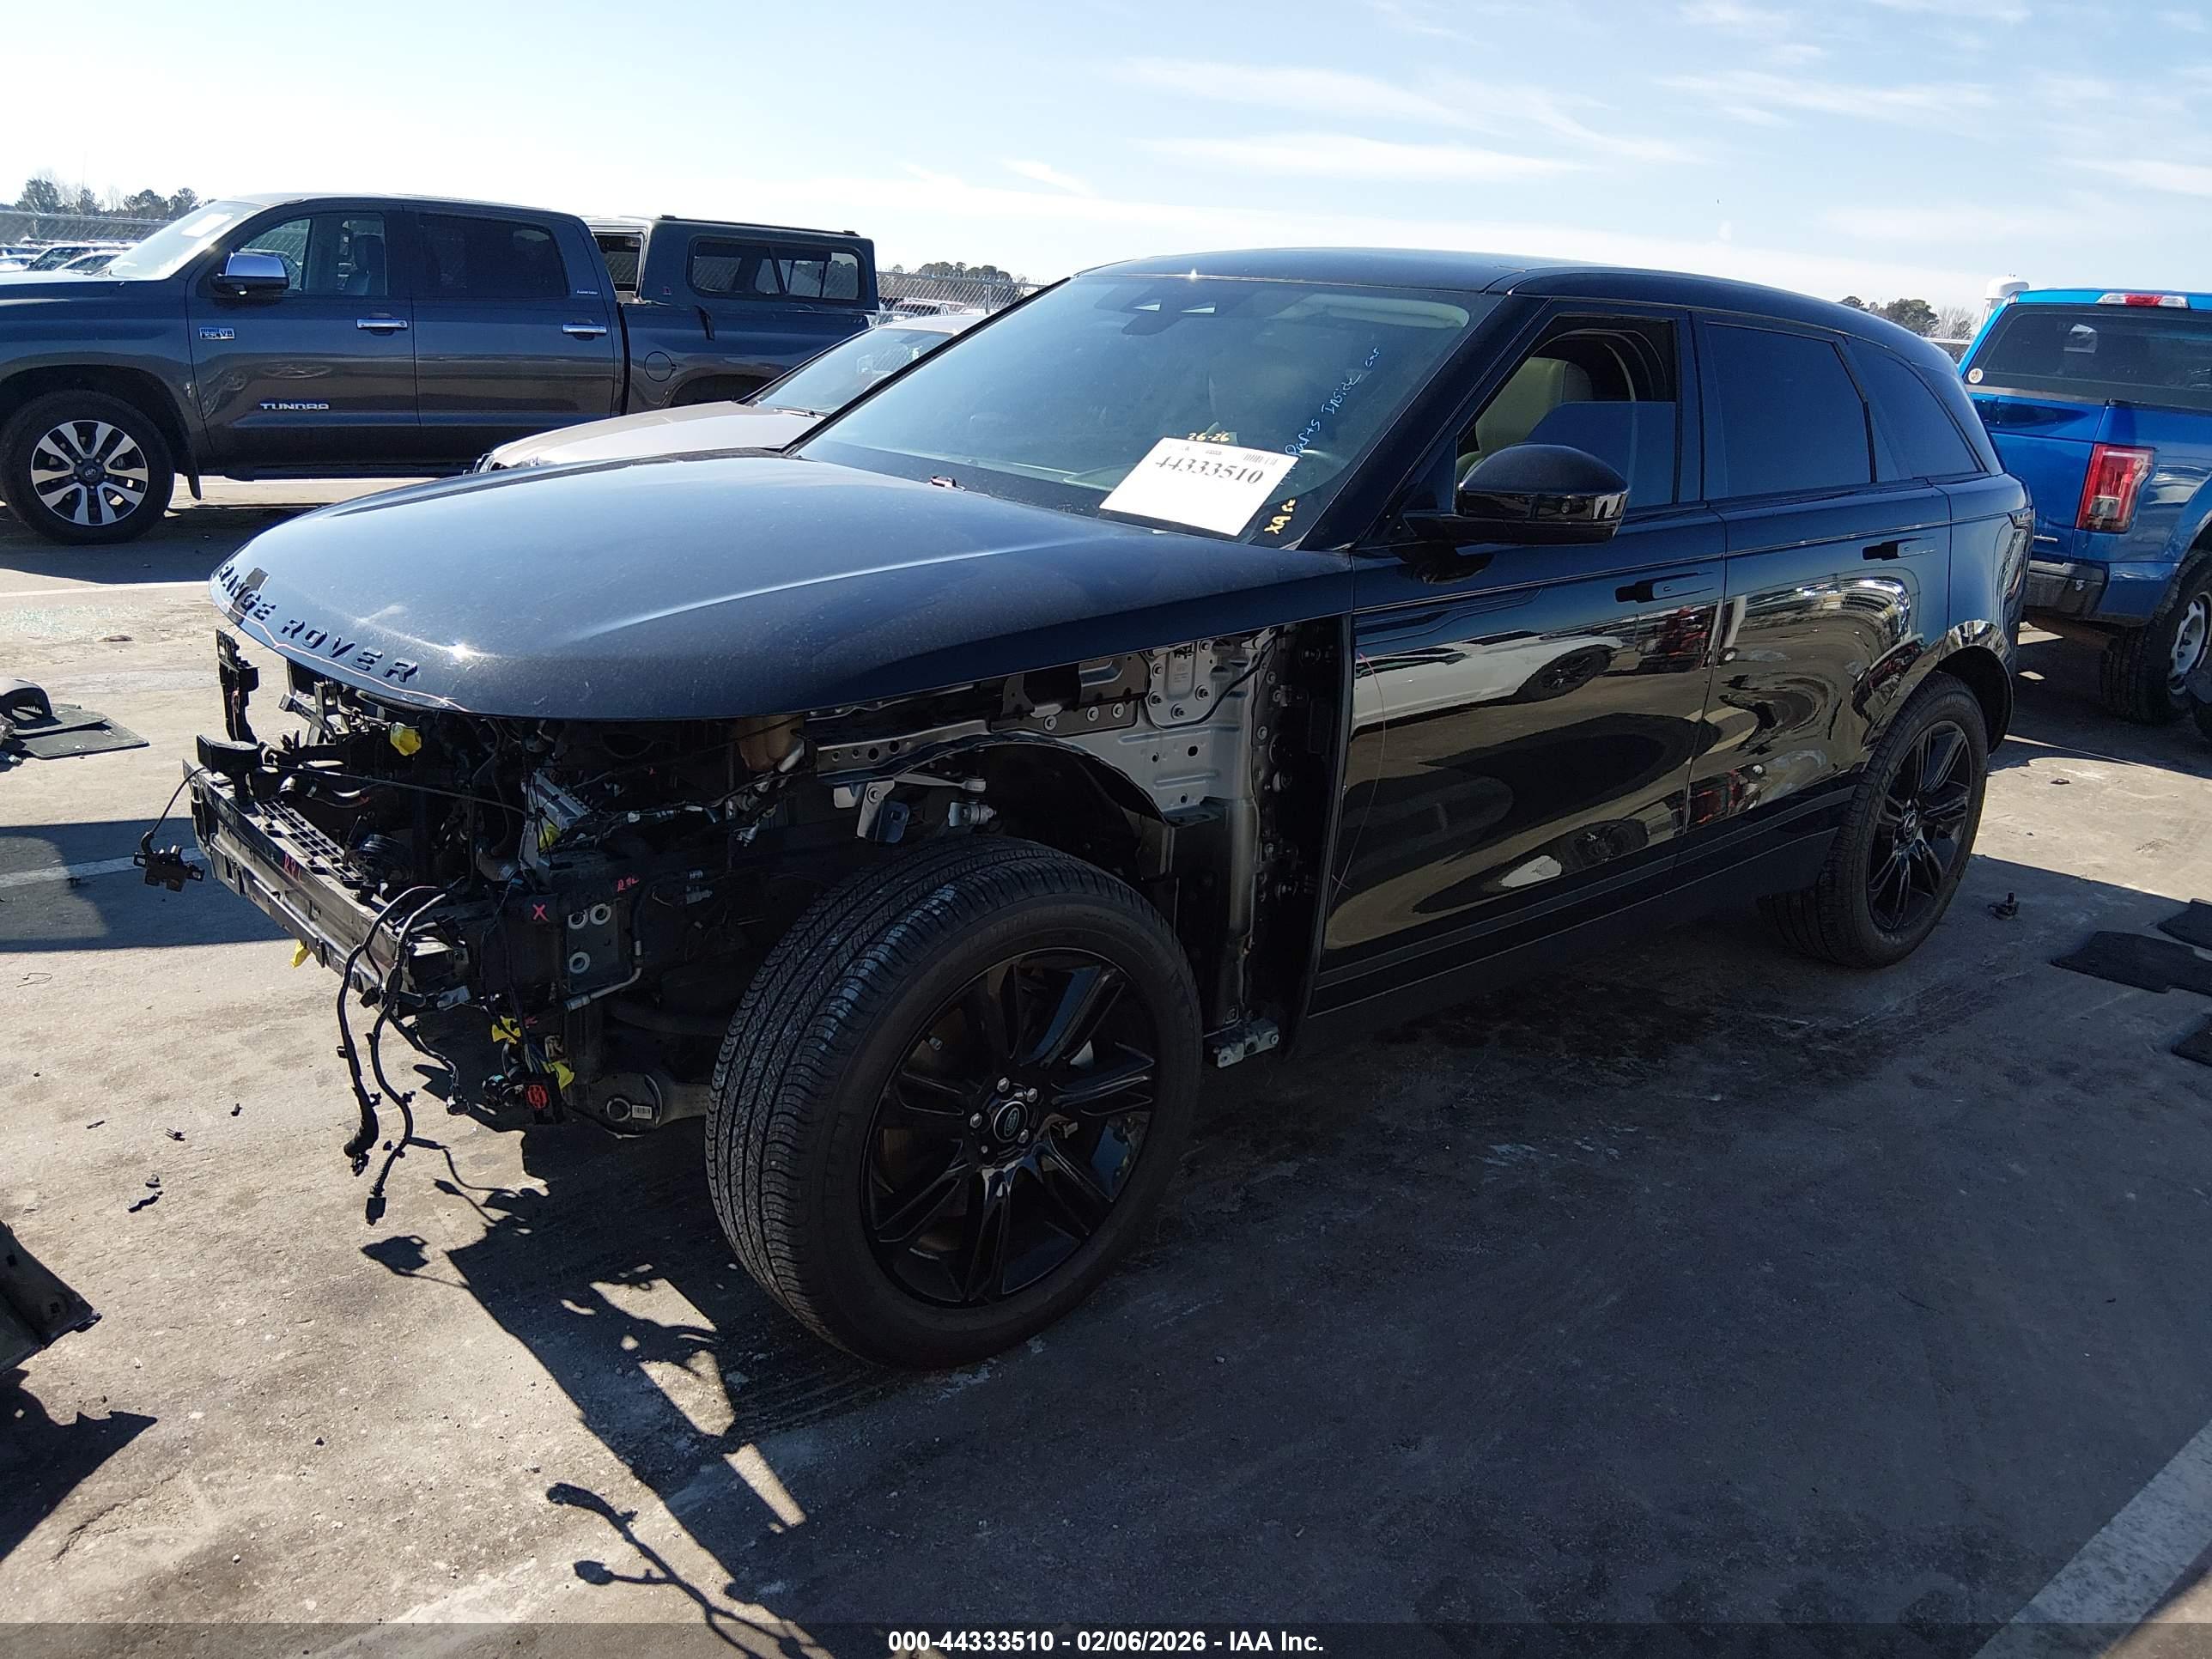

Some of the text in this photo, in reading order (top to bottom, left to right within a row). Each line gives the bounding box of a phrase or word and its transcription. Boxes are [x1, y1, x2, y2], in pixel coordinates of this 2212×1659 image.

[1156, 456, 1264, 484] 44333510
[219, 562, 419, 683] RANGE ROVER
